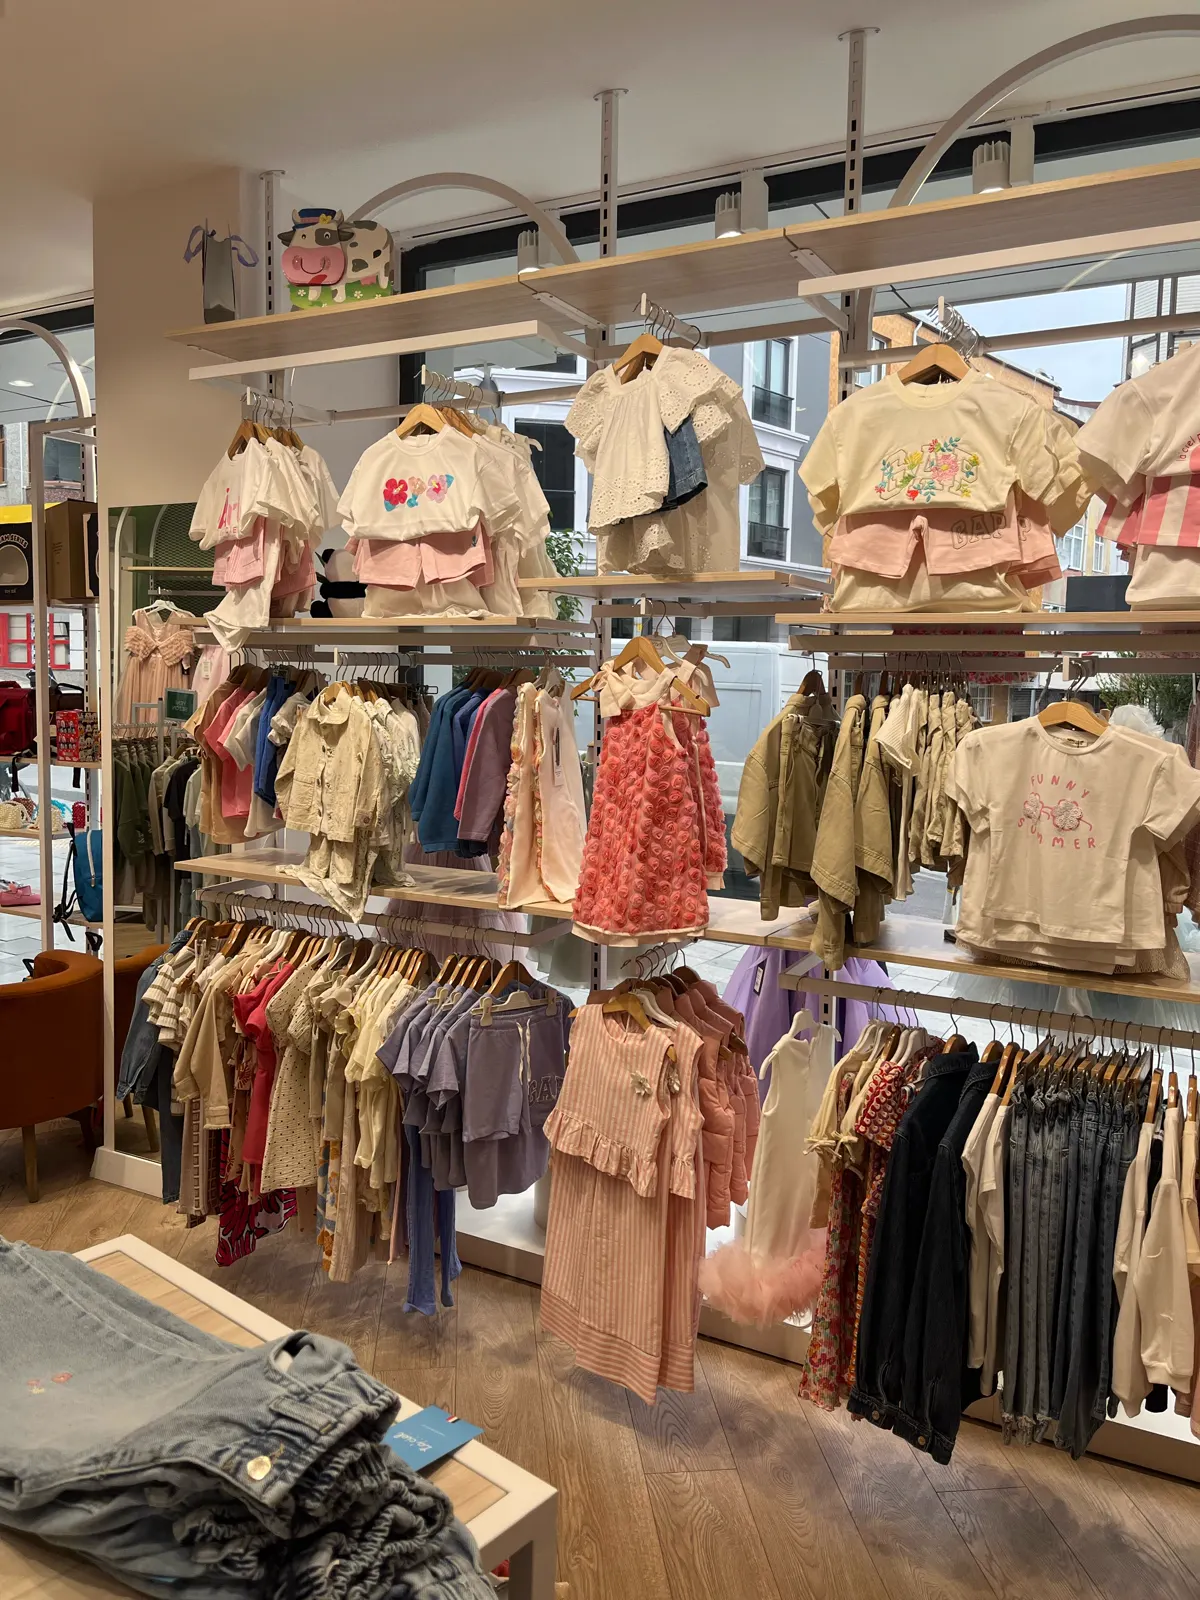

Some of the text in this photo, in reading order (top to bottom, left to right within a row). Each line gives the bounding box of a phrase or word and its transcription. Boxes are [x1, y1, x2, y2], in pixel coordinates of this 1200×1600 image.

[951, 512, 1007, 550] GAP
[1031, 773, 1090, 799] FUNNY
[1017, 817, 1096, 850] SUMMER
